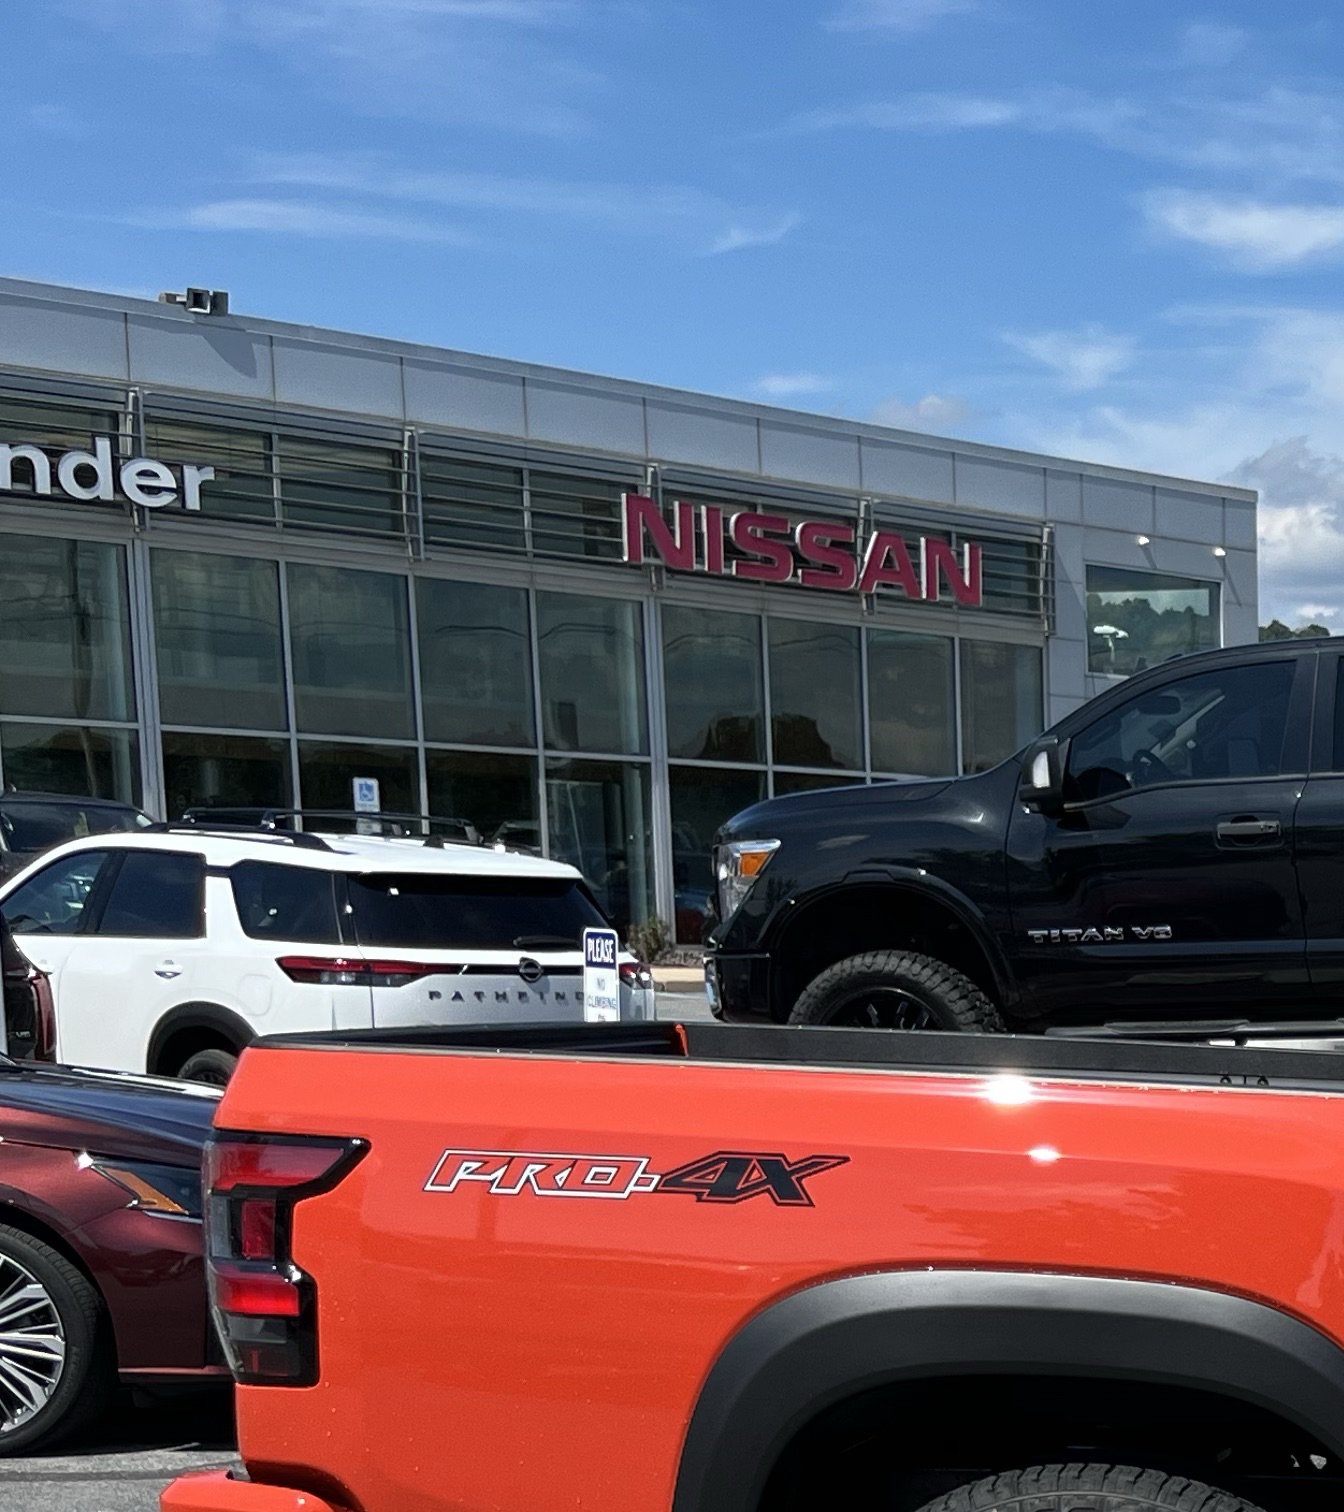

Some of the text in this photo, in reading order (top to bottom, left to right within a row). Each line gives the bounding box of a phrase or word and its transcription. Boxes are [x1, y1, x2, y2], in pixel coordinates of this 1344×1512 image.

[621, 492, 983, 607] NISSAN
[1027, 926, 1125, 944] TITAN
[586, 937, 615, 963] PLEASE
